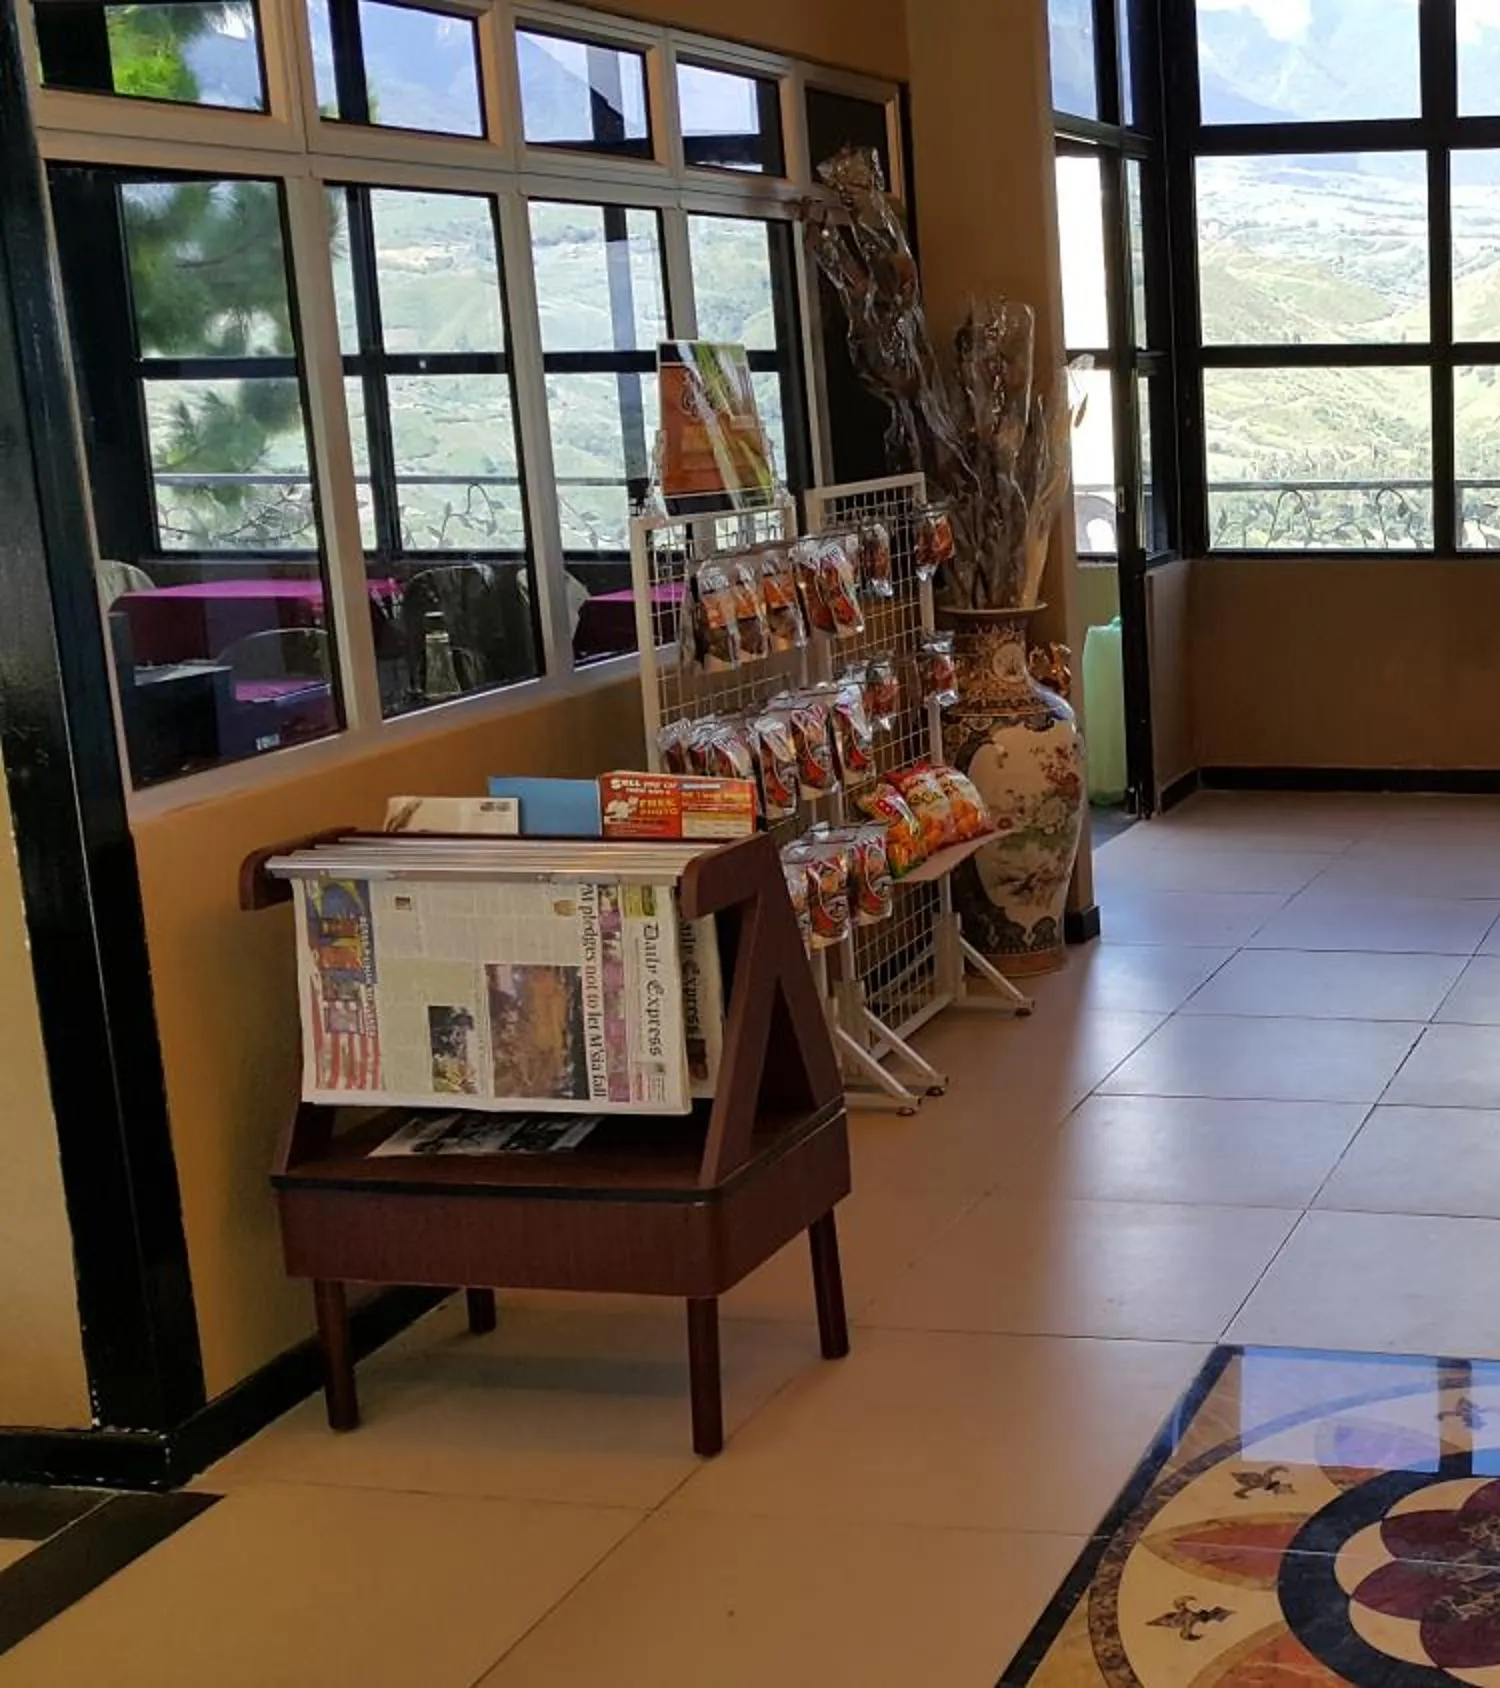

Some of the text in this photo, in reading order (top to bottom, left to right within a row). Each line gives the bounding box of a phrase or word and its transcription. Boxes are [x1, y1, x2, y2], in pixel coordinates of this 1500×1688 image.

[578, 881, 596, 902] M
[578, 904, 599, 961] pledges
[643, 920, 660, 975] Daily
[585, 965, 599, 991] not
[586, 992, 600, 1009] to
[645, 979, 665, 1057] Express
[592, 1074, 607, 1097] fall
